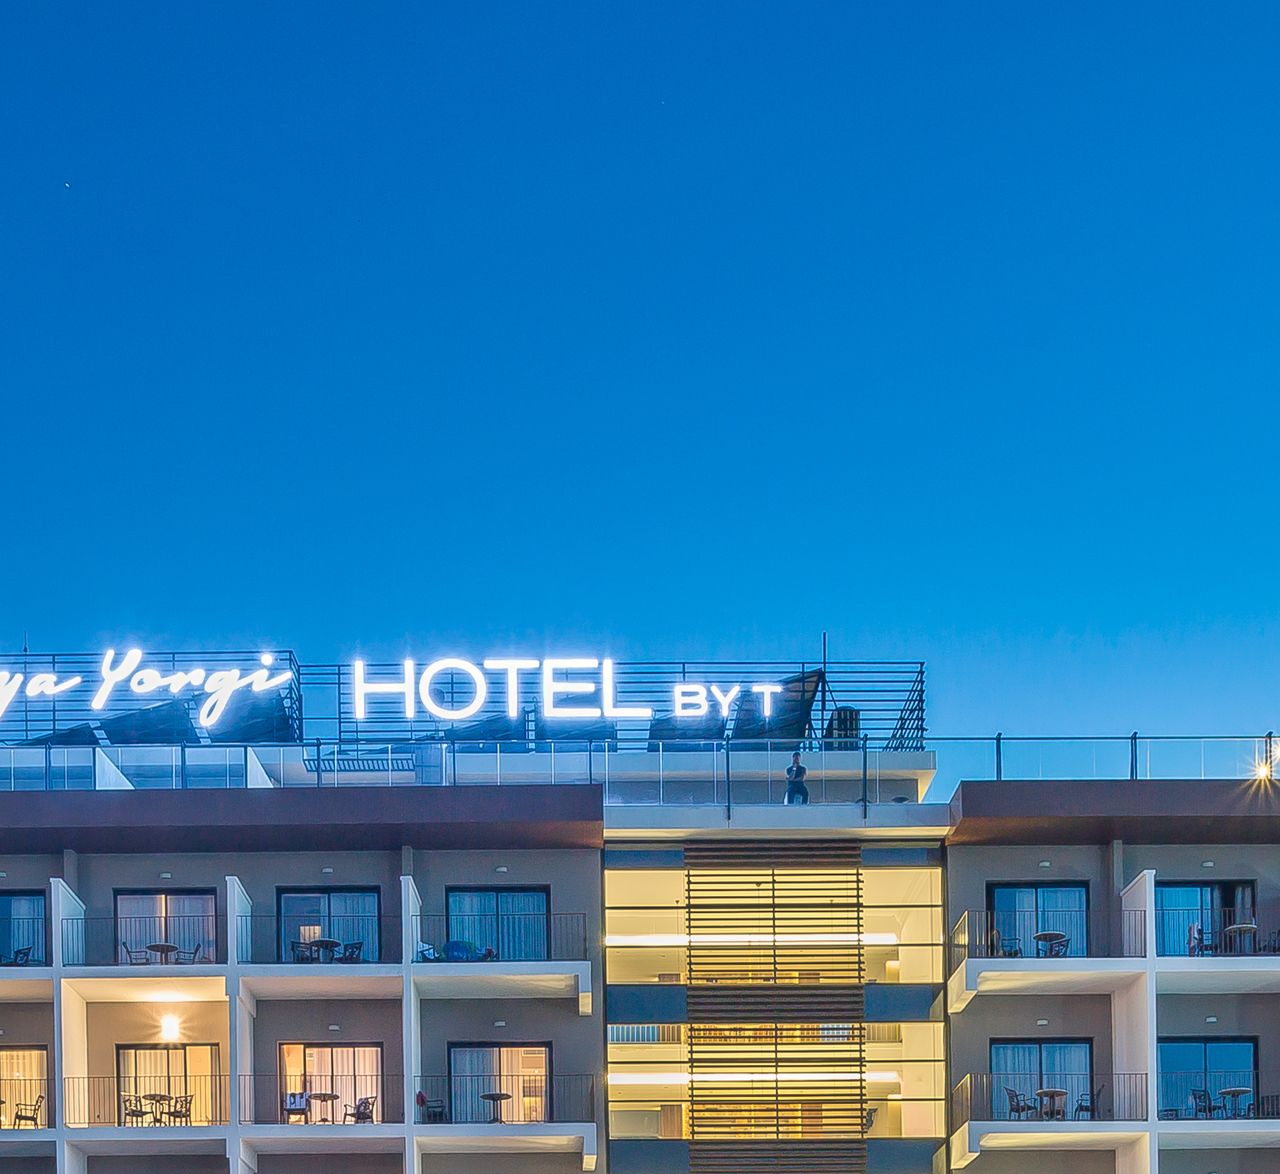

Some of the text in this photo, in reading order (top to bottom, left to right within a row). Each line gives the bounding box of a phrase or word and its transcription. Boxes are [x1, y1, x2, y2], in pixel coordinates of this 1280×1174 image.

[89, 647, 294, 728] Yorgi
[353, 657, 654, 721] HOTEL
[673, 683, 741, 718] BY
[751, 683, 784, 718] T
